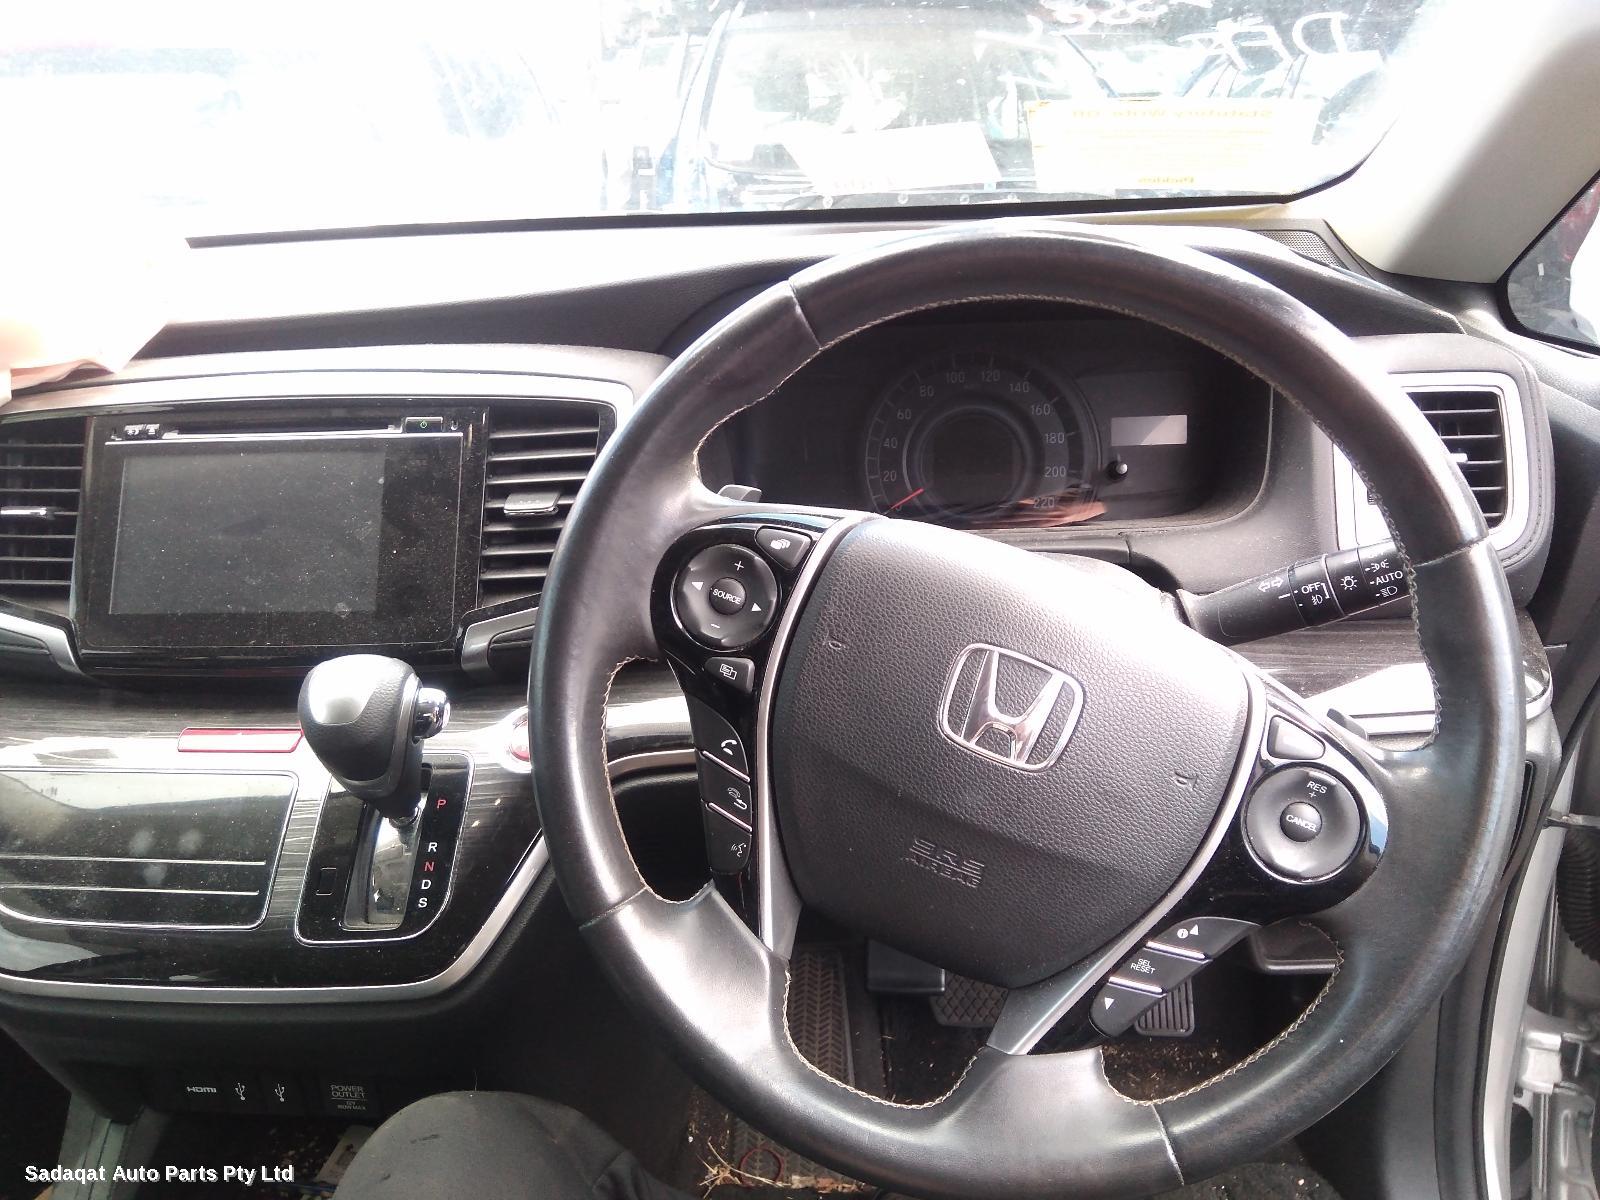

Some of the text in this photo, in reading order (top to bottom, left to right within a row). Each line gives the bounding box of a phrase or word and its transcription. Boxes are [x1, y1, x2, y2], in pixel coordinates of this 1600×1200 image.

[945, 371, 966, 384] 100
[981, 369, 1001, 383] 120
[919, 385, 935, 398] 80
[1009, 382, 1030, 394] 140
[896, 408, 912, 421] 60
[1030, 403, 1051, 417] 160
[883, 437, 898, 449] 40
[1044, 432, 1066, 445] 180
[882, 470, 897, 482] 20
[1043, 465, 1067, 478] 200
[1032, 497, 1056, 509] 220
[1375, 570, 1404, 586] AUTO
[1300, 581, 1322, 595] OFF
[712, 588, 742, 605] SOURCE
[1306, 780, 1328, 794] RES
[436, 799, 447, 809] P
[1285, 814, 1318, 833] CANCEL
[427, 841, 438, 853] R
[424, 861, 435, 872] N
[420, 879, 432, 890] D
[417, 897, 428, 909] S
[1130, 962, 1156, 975] RESET
[1137, 958, 1152, 968] SEL
[329, 1084, 364, 1092] POWER
[331, 1091, 366, 1099] OUTLET
